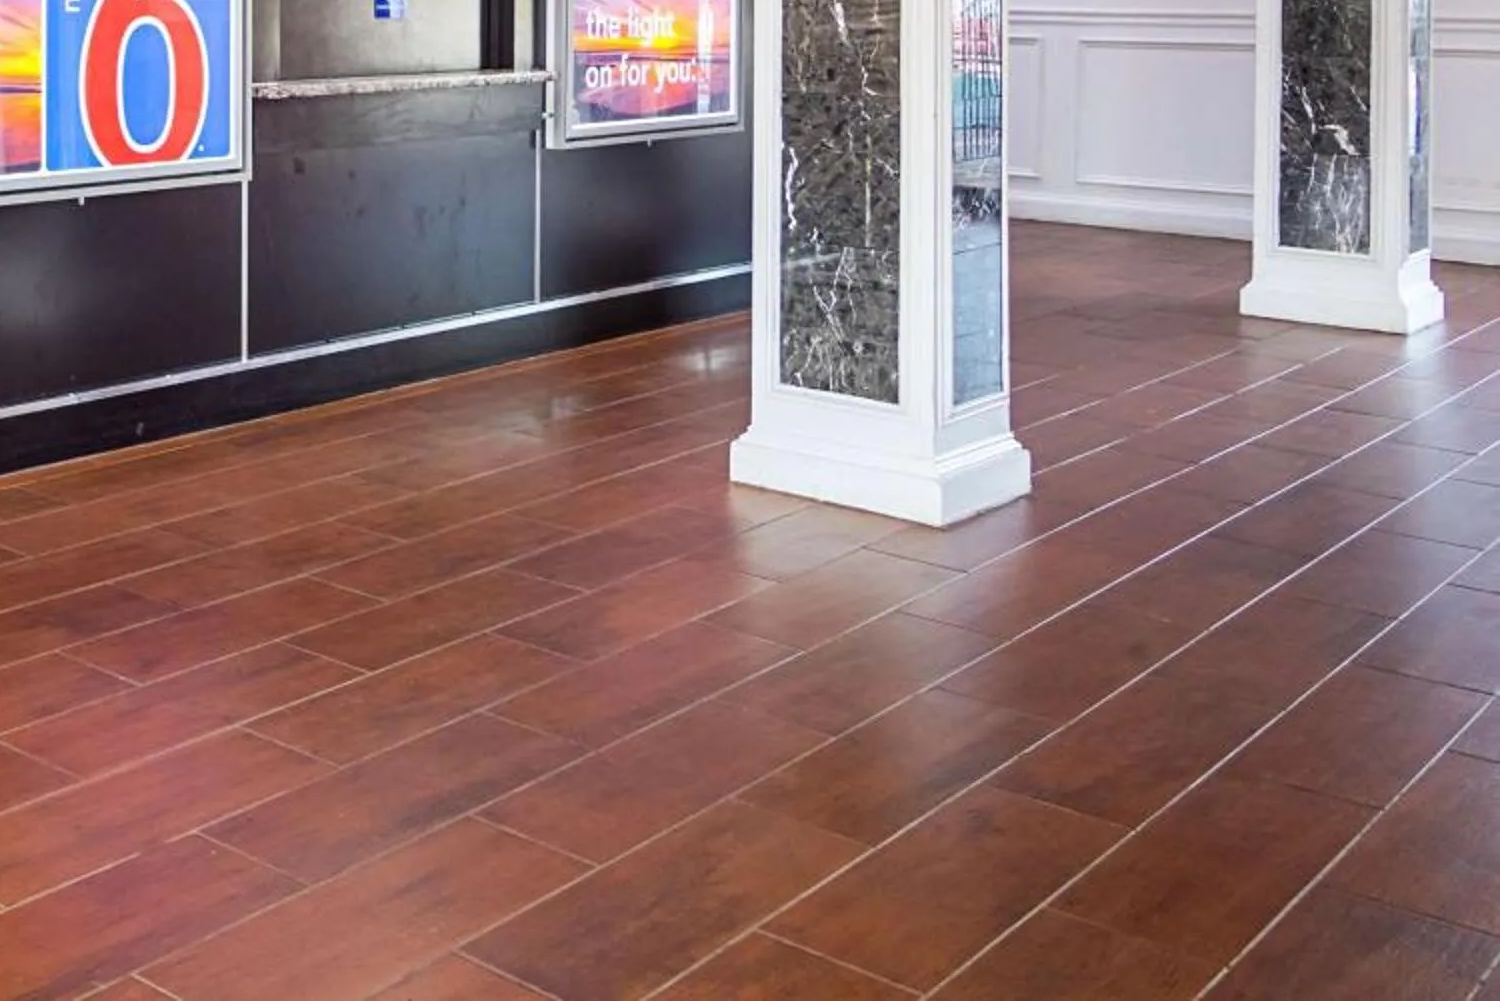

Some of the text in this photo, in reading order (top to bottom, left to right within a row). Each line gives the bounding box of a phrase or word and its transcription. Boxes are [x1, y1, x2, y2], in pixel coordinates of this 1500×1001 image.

[586, 7, 676, 47] the light
[585, 63, 613, 89] on
[620, 53, 649, 86] for
